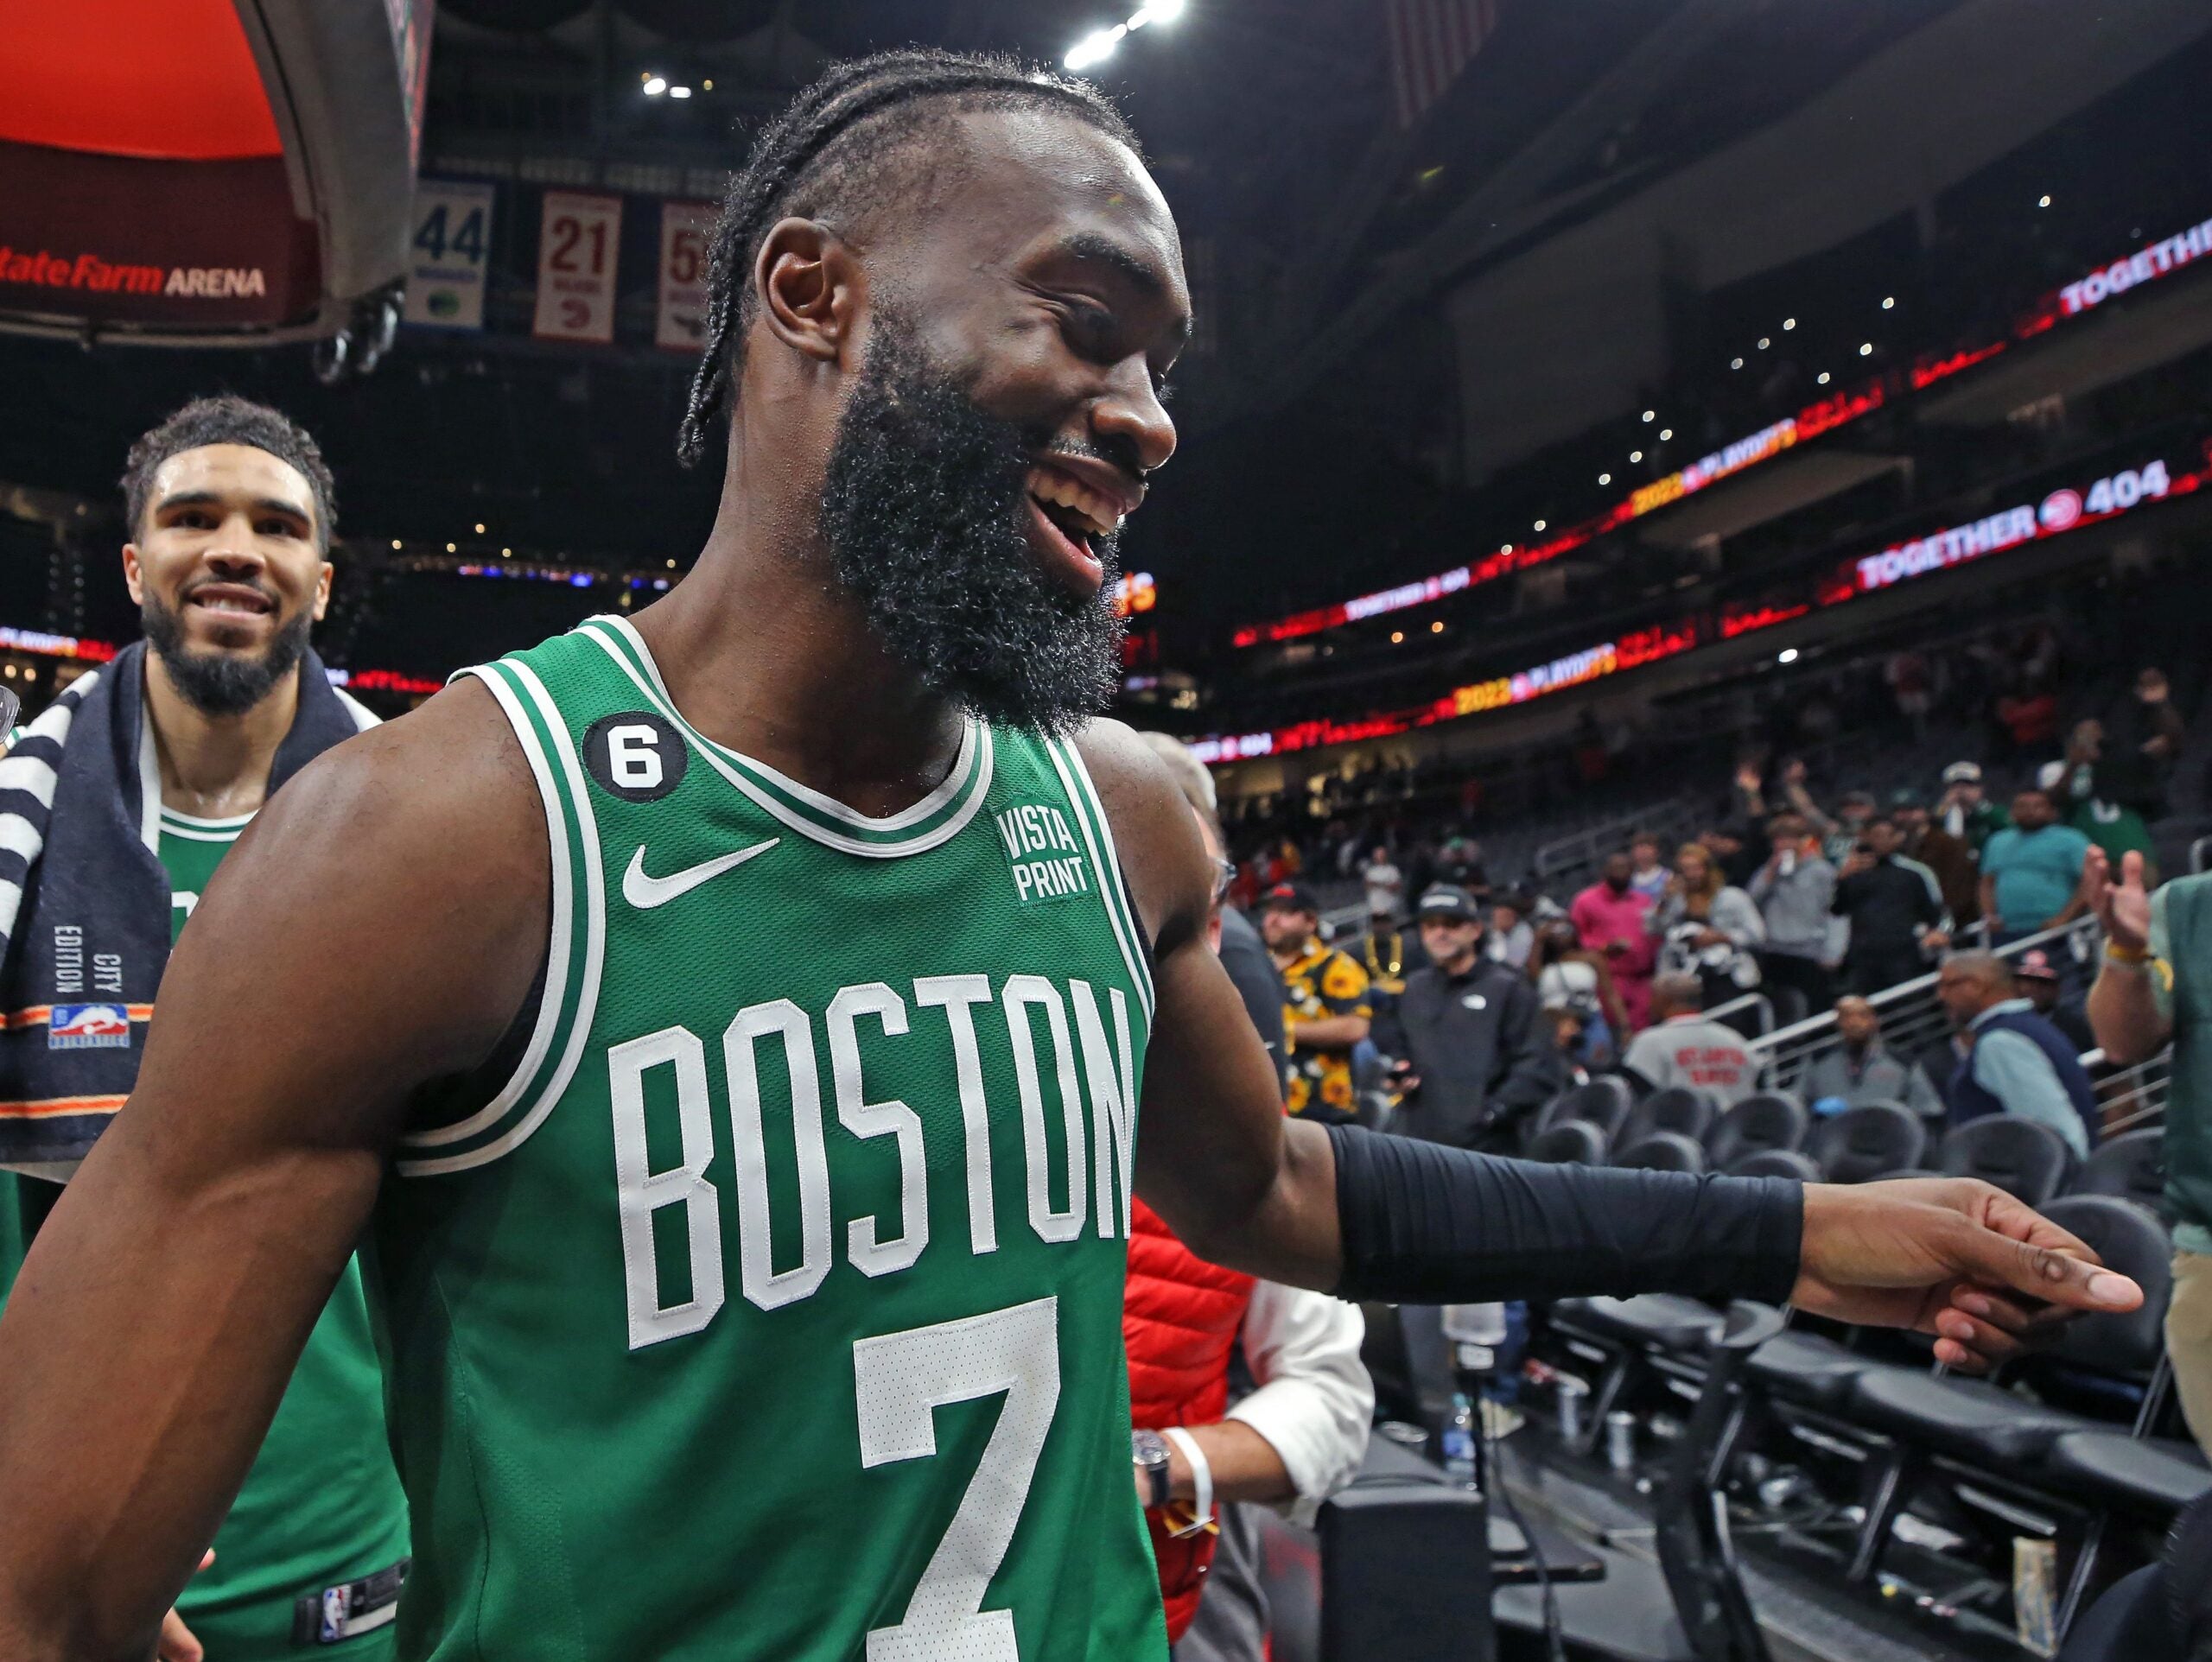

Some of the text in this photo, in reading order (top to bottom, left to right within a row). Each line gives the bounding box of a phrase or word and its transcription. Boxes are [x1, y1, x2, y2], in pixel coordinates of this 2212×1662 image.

[413, 204, 483, 264] 44
[550, 216, 609, 274] 21
[670, 229, 709, 284] 5
[0, 246, 266, 297] tateFarm ARENA
[2060, 217, 2212, 313] TOGETHE
[1857, 459, 2171, 590] TOGETHER 404
[607, 724, 664, 788] 6
[996, 805, 1079, 860] VISTA
[1012, 856, 1088, 901] PRINT
[54, 926, 84, 993] EDITION
[93, 954, 123, 993] CITY
[607, 974, 1135, 1350] BOSTON
[853, 1295, 1061, 1662] 7
